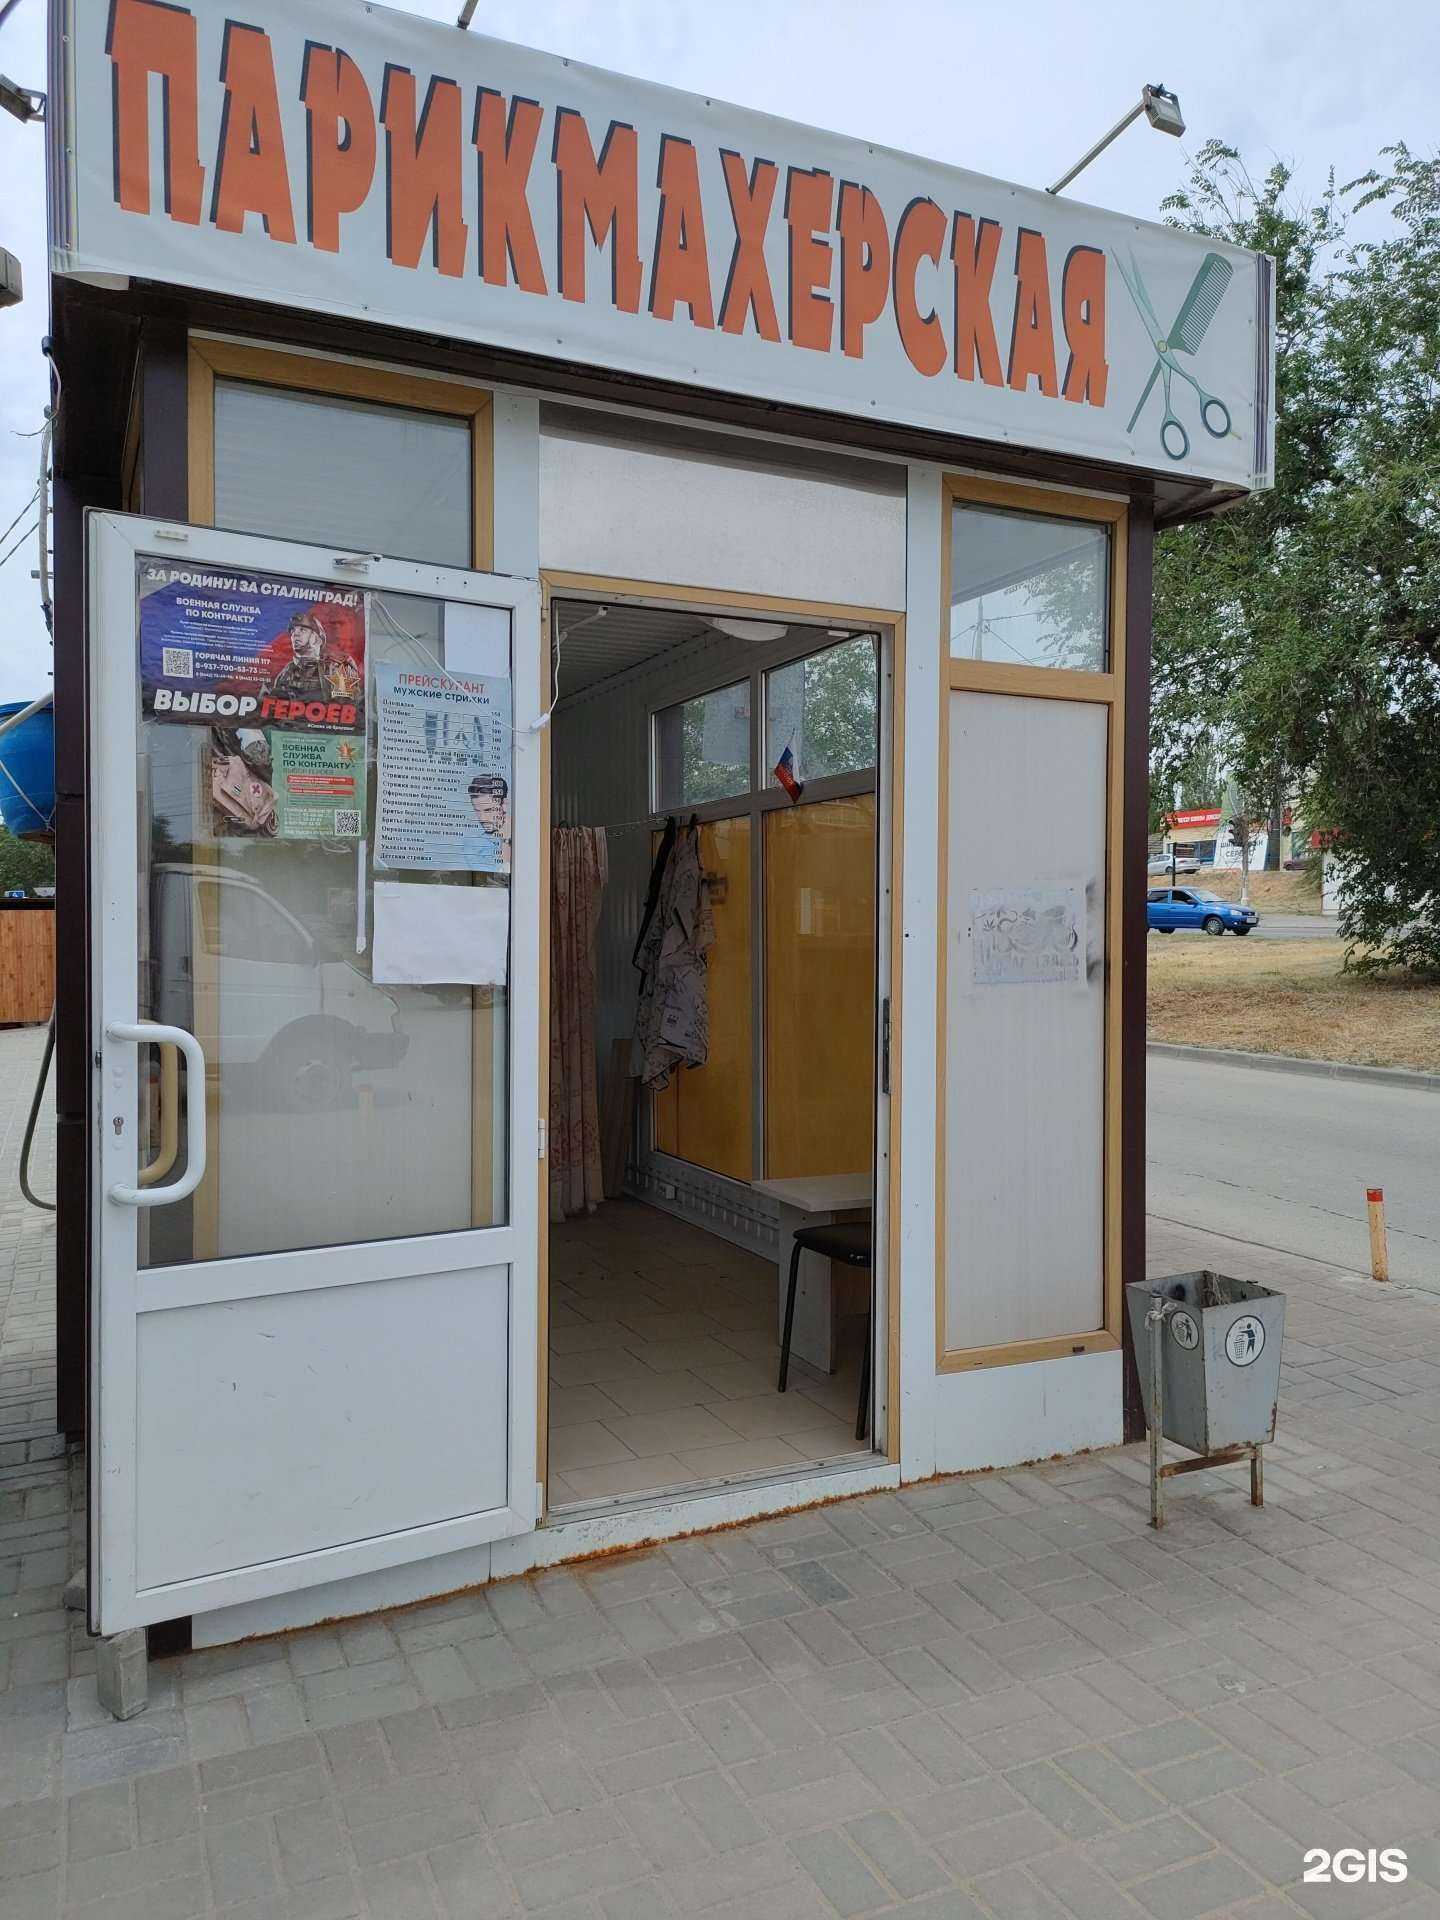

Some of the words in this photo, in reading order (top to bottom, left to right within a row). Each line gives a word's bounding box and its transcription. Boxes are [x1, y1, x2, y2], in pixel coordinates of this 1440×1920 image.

[105, 0, 1109, 408] ПАРИКМАХЕРСКАЯ
[146, 568, 167, 582] ЗА
[169, 570, 238, 590] РОДИНУ!
[239, 580, 259, 594] ЗА
[260, 583, 358, 607] СТАЛИНГРАД!
[176, 597, 220, 610] ВОЕННАЯ
[221, 603, 261, 615] СЛУЖБА
[185, 608, 200, 617] ПО
[201, 611, 255, 624] КОНТРАКТУ
[195, 652, 231, 662] ГОРЯЧАЯ
[232, 656, 260, 664] ЛИНИЯ
[399, 673, 485, 694] ПРЕЙСКУРАНТ
[153, 689, 258, 717] ВЫБОР
[260, 696, 357, 724] ГЕРОЕВ
[282, 743, 326, 753] ВОЕННАЯ
[282, 752, 323, 761] СЛУЖБА
[298, 761, 350, 770] КОНТРАКТУ
